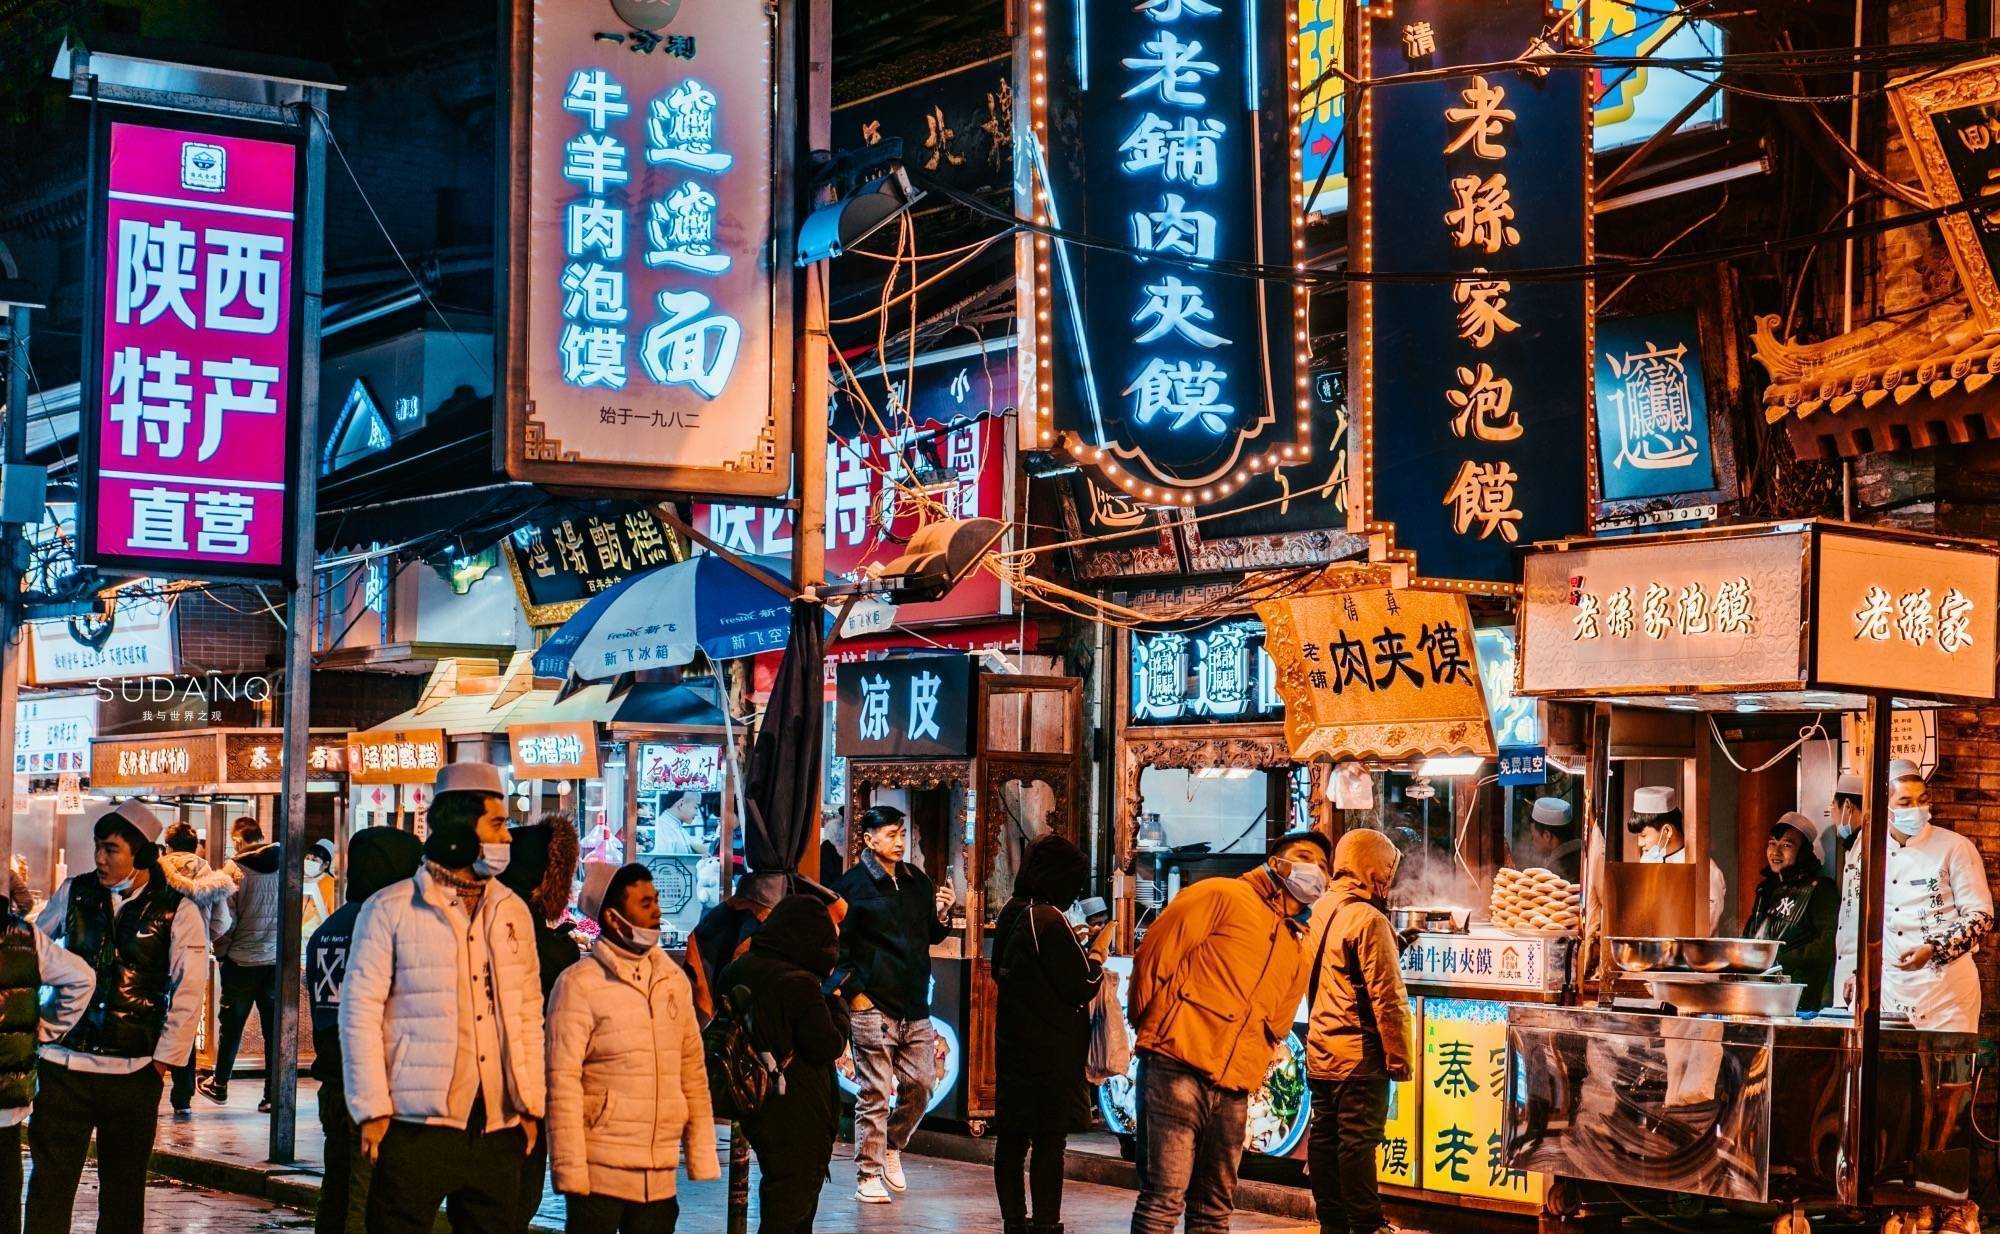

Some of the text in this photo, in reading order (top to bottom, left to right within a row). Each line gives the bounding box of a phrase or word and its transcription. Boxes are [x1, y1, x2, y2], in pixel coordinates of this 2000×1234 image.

[594, 30, 697, 59] 一分利
[564, 70, 629, 390] 牛羊肉泡馍
[115, 219, 284, 334] 陕西
[1443, 75, 1524, 543] 老孫家泡饃
[109, 346, 279, 462] 特产
[600, 406, 700, 429] 始于一九八二
[127, 486, 254, 555] 直营
[644, 623, 677, 634] 新飞
[1853, 587, 1974, 653] 老孫家
[731, 625, 791, 650] 新飞空
[604, 644, 669, 666] 新飞冰箱
[1329, 620, 1474, 695] 肉夹馍
[859, 670, 942, 741] 凉皮
[250, 746, 328, 770] 秦香
[647, 756, 716, 778] 石榴汁
[1500, 755, 1544, 775] 免费真空
[1776, 897, 1795, 916] NY
